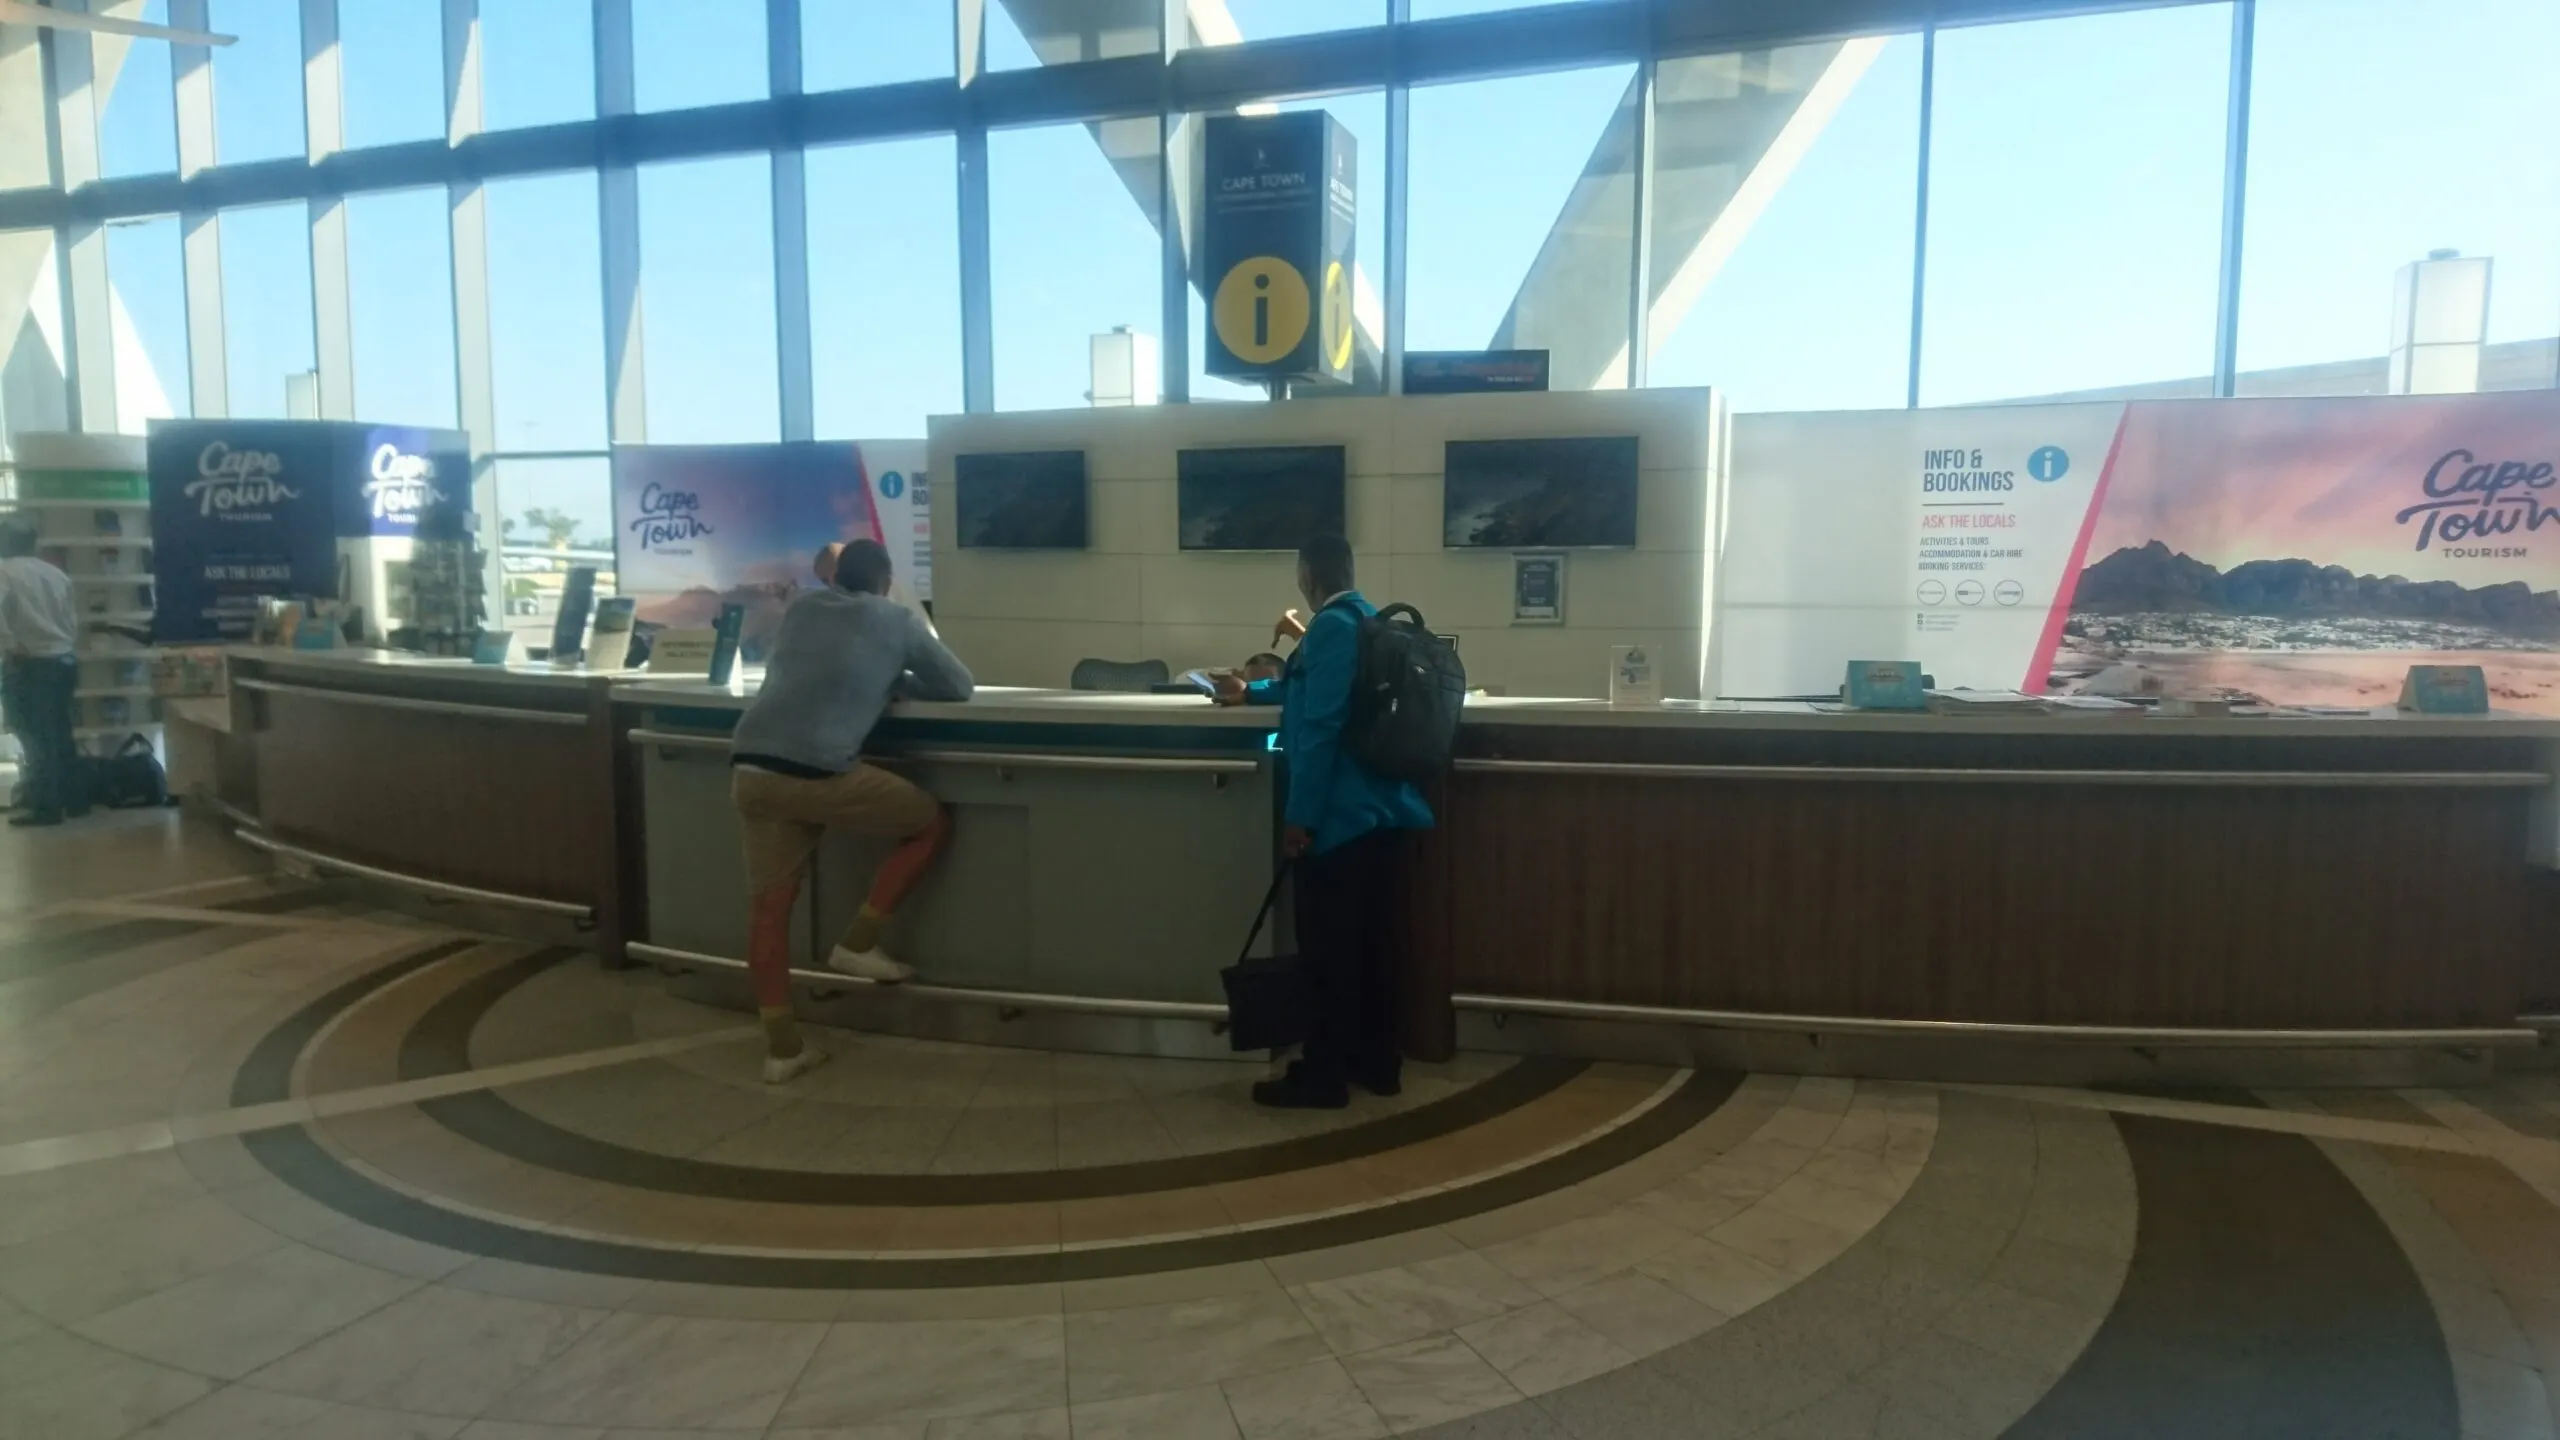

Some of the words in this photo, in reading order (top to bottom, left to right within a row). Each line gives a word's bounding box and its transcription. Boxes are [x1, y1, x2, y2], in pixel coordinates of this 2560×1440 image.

[1222, 176, 1257, 191] CAPE
[1261, 172, 1305, 188] TOWN
[198, 441, 281, 481] Cape
[1924, 450, 1965, 470] INFO
[1971, 449, 1983, 469] &
[1923, 471, 2014, 493] BOOKINGS
[2423, 449, 2558, 507] Cape
[184, 477, 300, 516] Town
[641, 481, 699, 521] Cape
[630, 514, 715, 550] Town
[1922, 515, 1945, 529] ASK
[1949, 514, 1970, 529] THE
[1972, 513, 2016, 529] LOCALS
[2395, 497, 2560, 552] Town
[1920, 550, 1981, 558] ACCOMMODATION
[1990, 549, 2005, 558] CAR
[2006, 549, 2023, 558] HIRE
[2442, 548, 2527, 558] TOURISM
